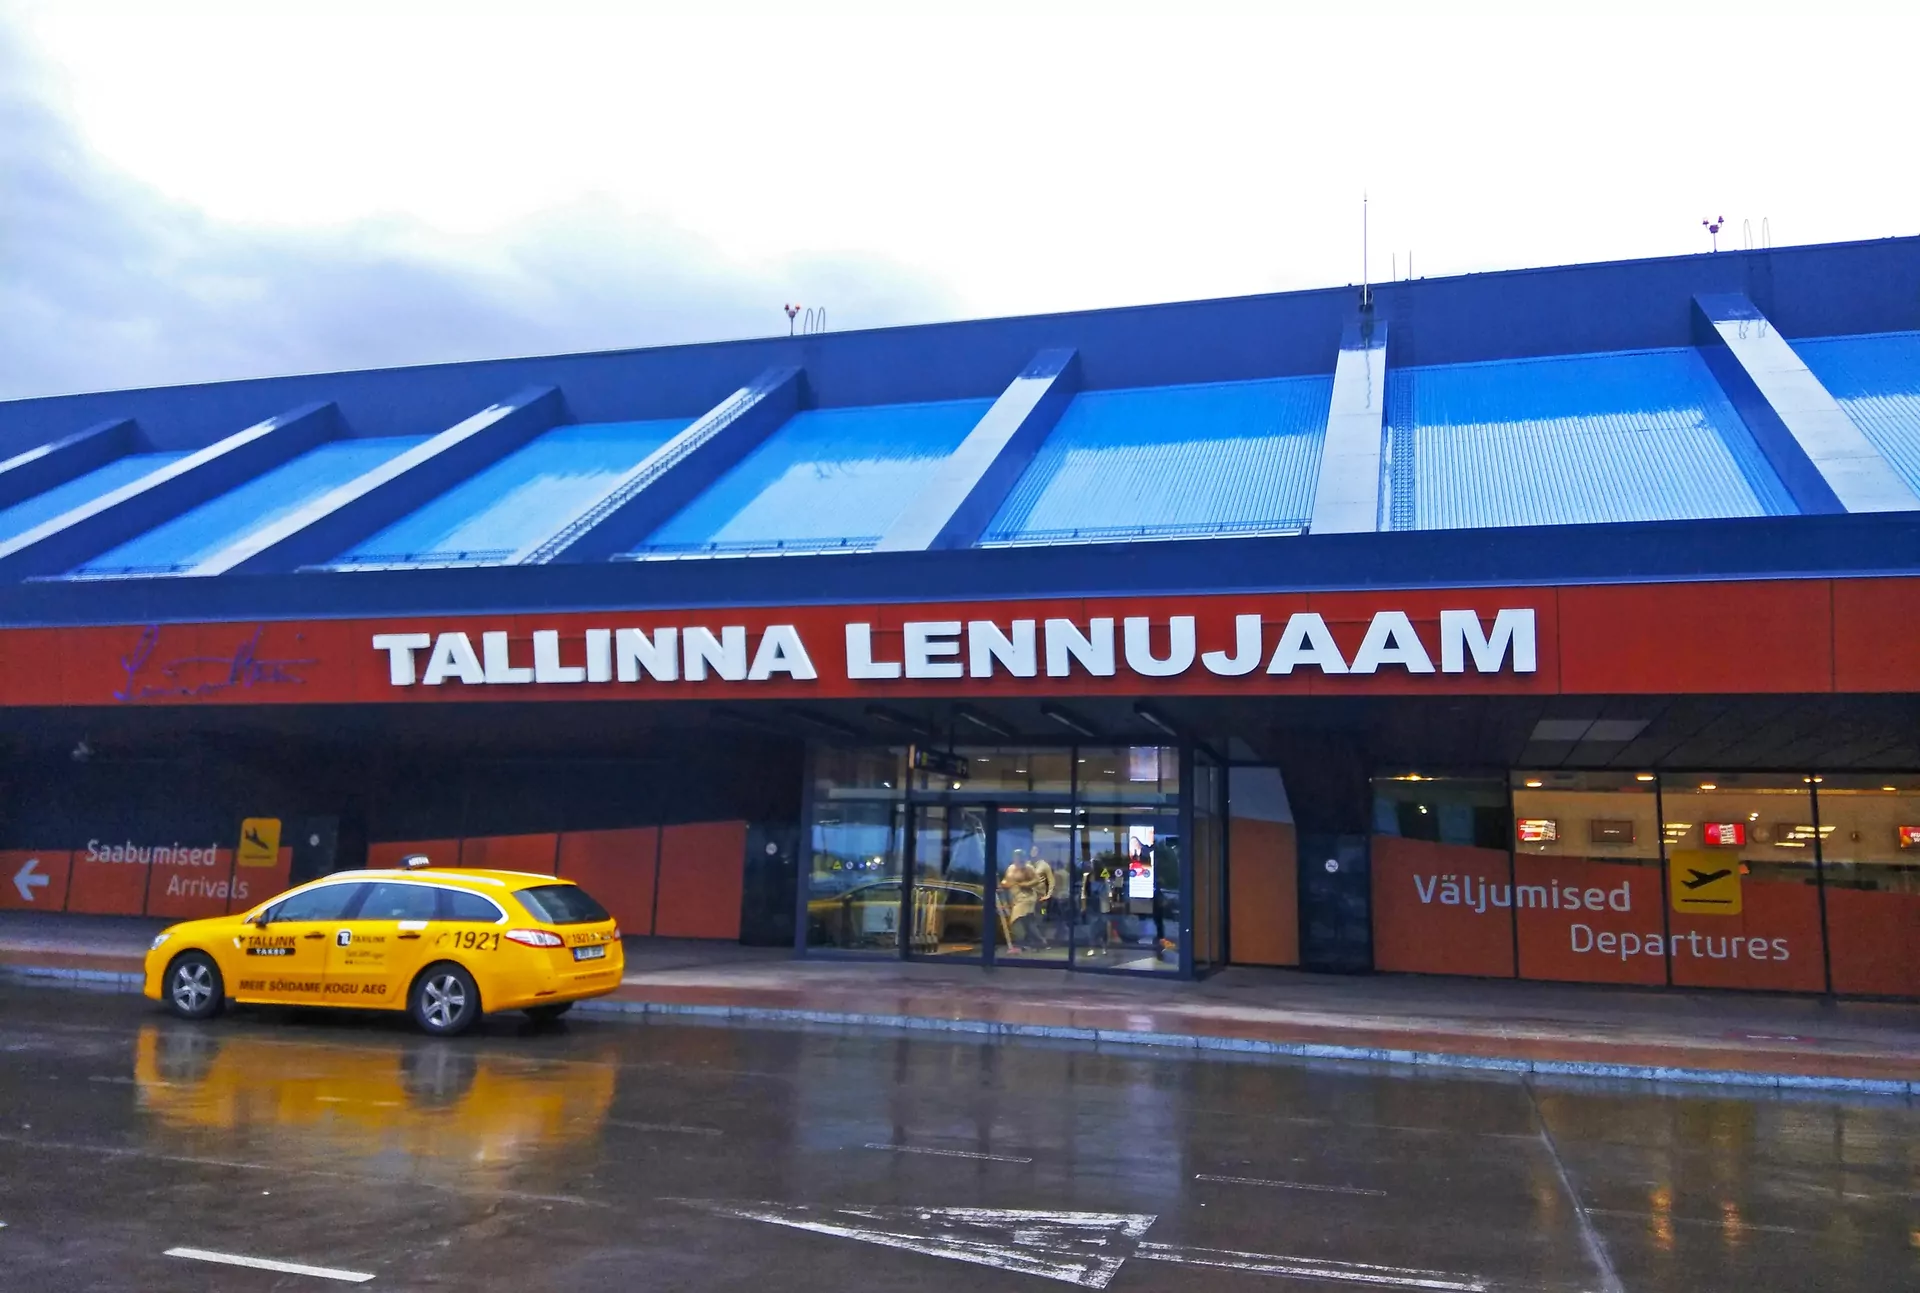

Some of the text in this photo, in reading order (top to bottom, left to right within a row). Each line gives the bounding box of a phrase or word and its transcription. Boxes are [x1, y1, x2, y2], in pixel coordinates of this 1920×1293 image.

[373, 625, 818, 686] TALLINNA
[846, 608, 1537, 681] LENNUJAAM
[86, 840, 217, 866] Saabumised
[167, 874, 248, 899] Arrivals
[1413, 874, 1631, 913] Väljumised
[247, 935, 296, 947] TALLINK
[454, 931, 500, 951] 1921
[1570, 923, 1790, 961] Departures
[239, 979, 267, 991] MEIE
[323, 983, 358, 994] KOGU
[361, 983, 387, 995] AEG
